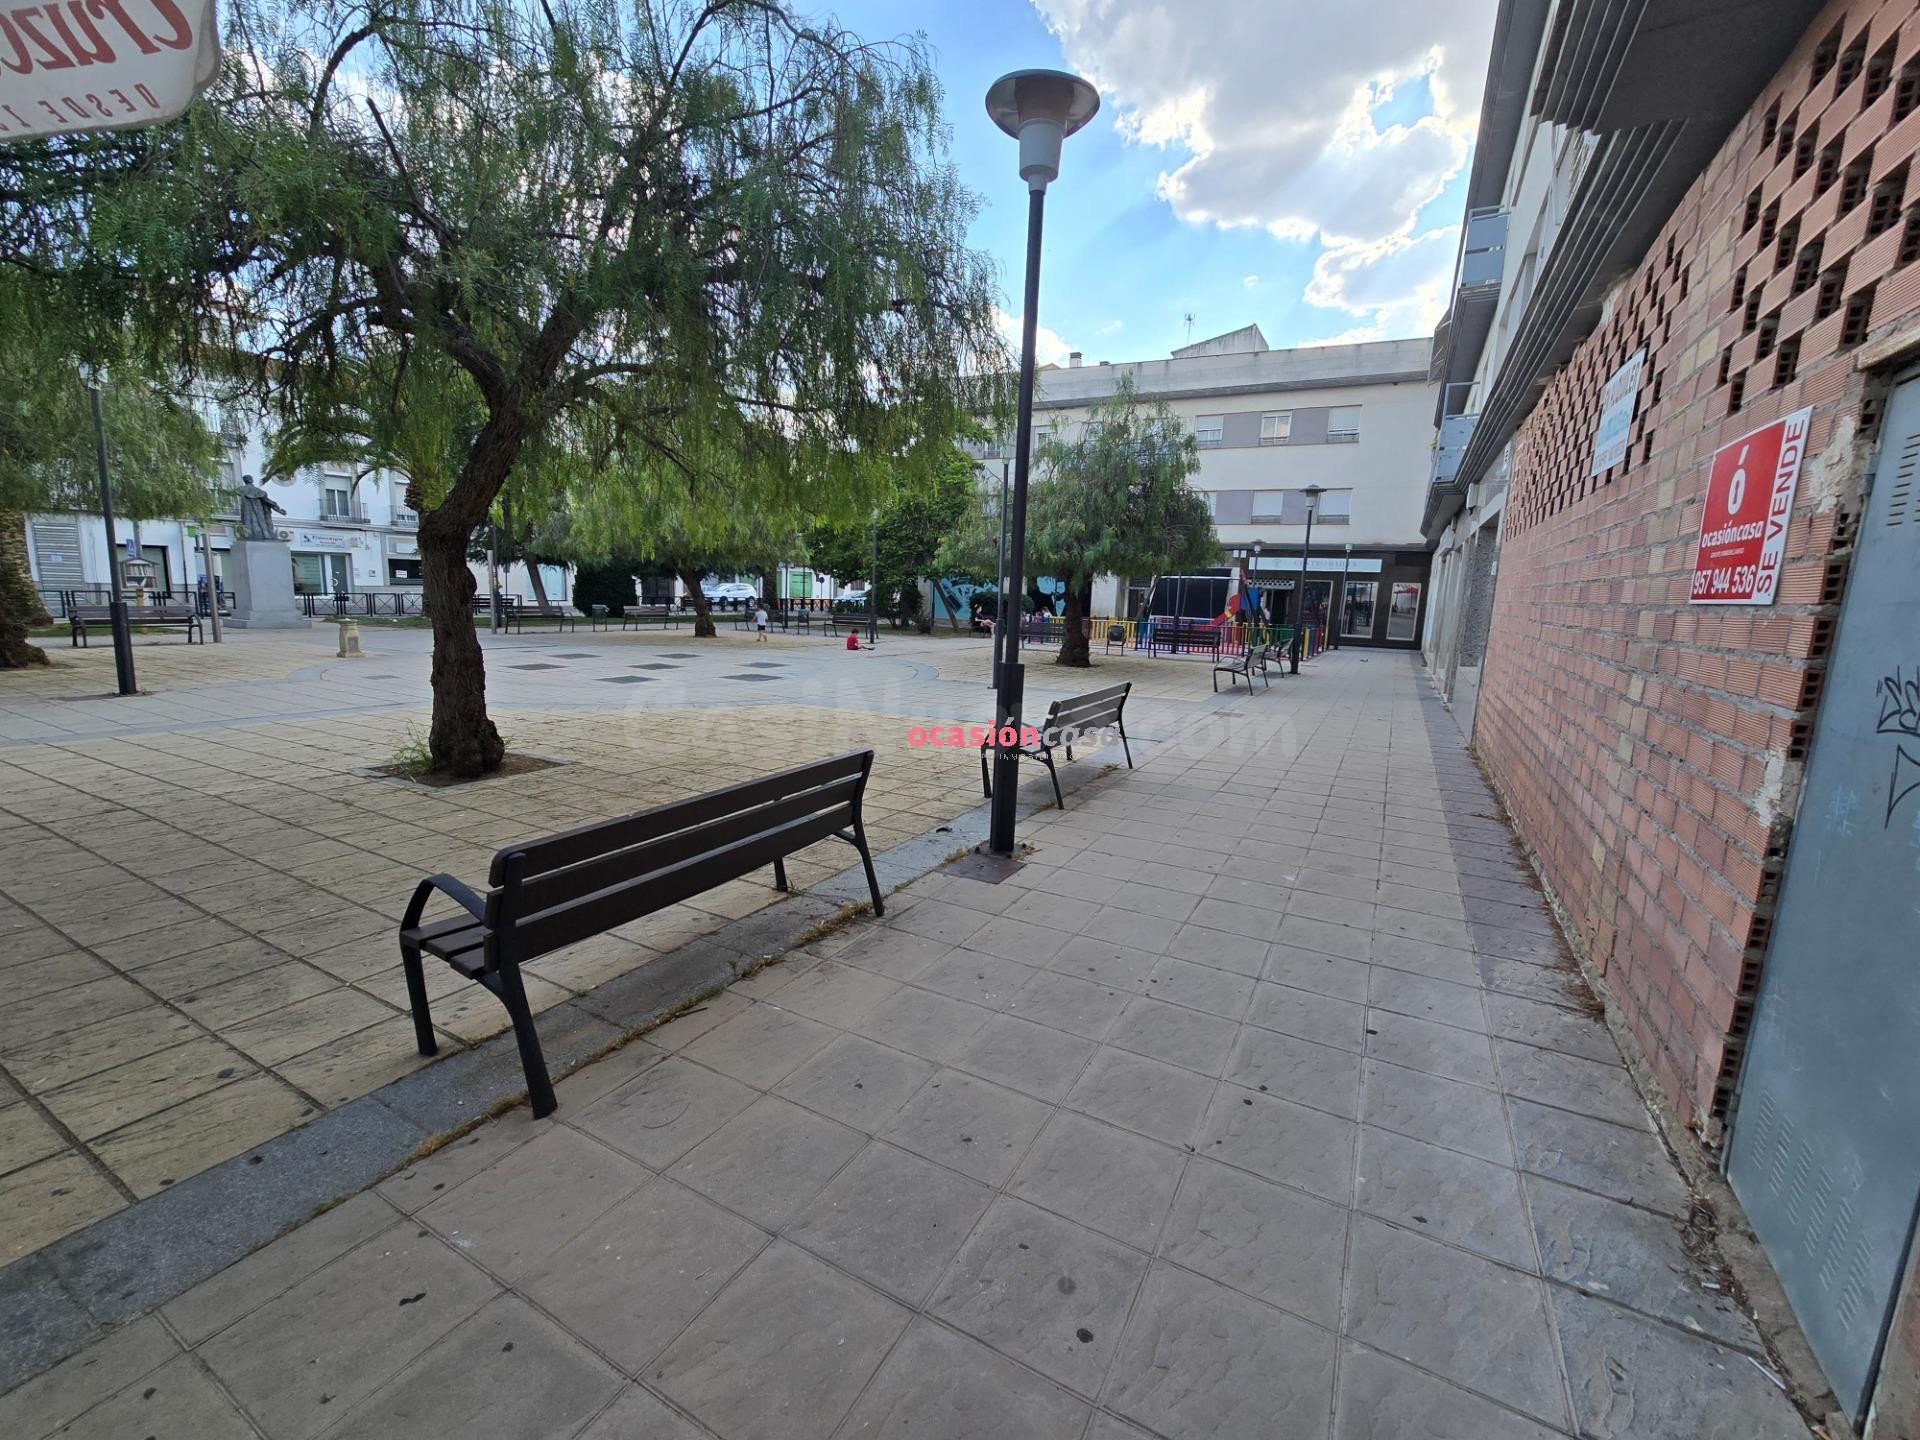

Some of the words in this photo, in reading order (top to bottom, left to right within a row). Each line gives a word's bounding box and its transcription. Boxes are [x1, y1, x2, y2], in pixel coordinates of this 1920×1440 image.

[1767, 419, 1805, 541] VENDE
[1701, 520, 1765, 548] ocasióncasa
[1693, 569, 1713, 594] 957
[1711, 567, 1732, 594] 944
[1732, 564, 1757, 593] 536
[1756, 551, 1779, 593] SE
